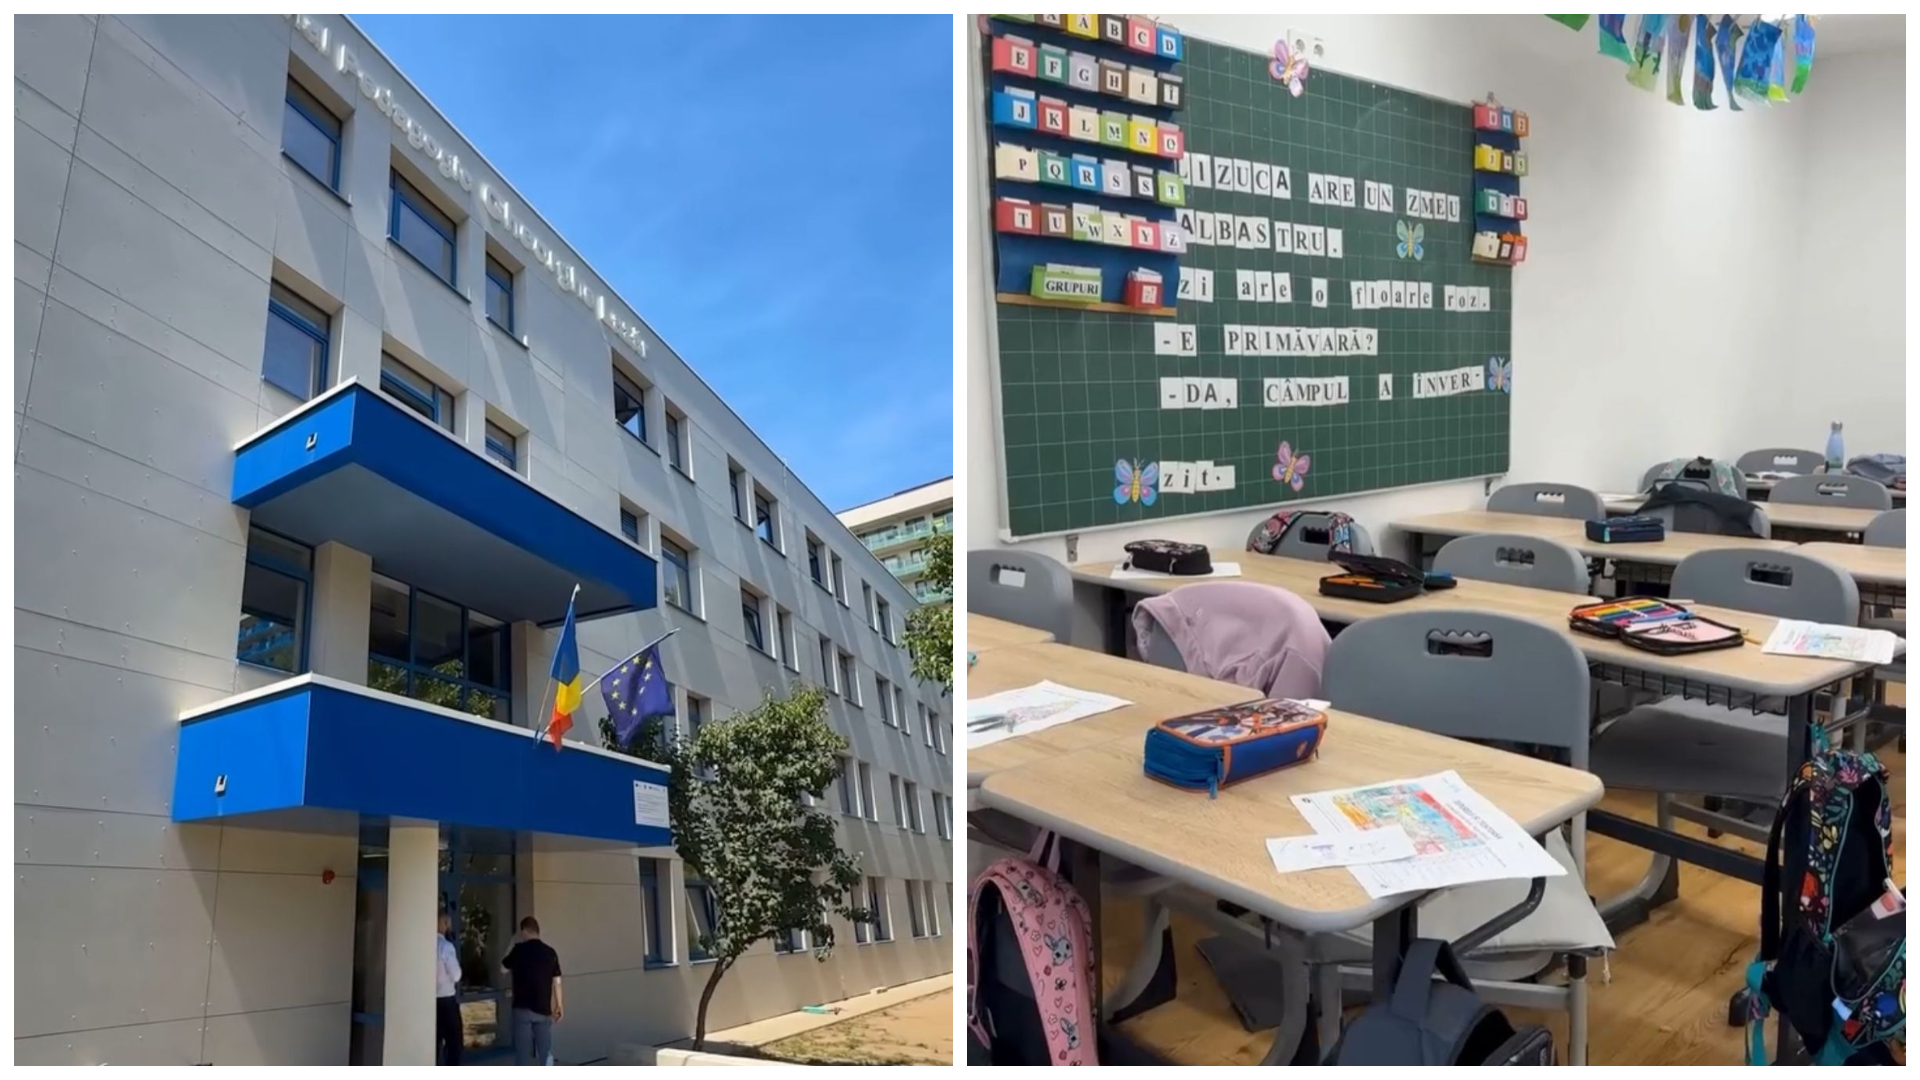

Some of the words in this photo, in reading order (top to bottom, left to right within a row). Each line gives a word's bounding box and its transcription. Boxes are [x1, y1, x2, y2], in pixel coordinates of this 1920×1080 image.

[1110, 23, 1119, 36] B
[1138, 31, 1147, 44] C
[1165, 39, 1174, 52] D
[1016, 51, 1026, 66] E
[1049, 60, 1058, 74] F
[1079, 69, 1089, 82] G
[1109, 75, 1119, 88] H
[1018, 105, 1025, 119] J
[1049, 112, 1060, 127] K
[1082, 119, 1091, 133] L
[1108, 125, 1120, 140] M
[1139, 131, 1147, 144] N
[1166, 138, 1175, 150] O
[1019, 158, 1027, 171] P
[1050, 164, 1061, 179] Q
[1082, 169, 1093, 184] R
[1112, 174, 1121, 188] S
[1311, 180, 1353, 203] ARE
[1366, 187, 1392, 208] UN
[1408, 193, 1458, 218] ZMEU
[1052, 217, 1062, 230] U
[1076, 216, 1086, 228] V
[1088, 224, 1100, 237] W
[1113, 224, 1122, 237] X
[1141, 229, 1150, 242] Y
[1046, 280, 1099, 295] GRUPURI
[1241, 281, 1287, 298] are
[1315, 289, 1324, 303] o
[1356, 287, 1430, 305] floare
[1447, 294, 1487, 308] roz.
[1228, 329, 1373, 351] PRIMĂVARĂ?
[1266, 379, 1347, 402] CÂMPUL
[1381, 380, 1391, 396] A
[1417, 372, 1480, 395] ÎNVER-
[1163, 469, 1220, 488] zit.
